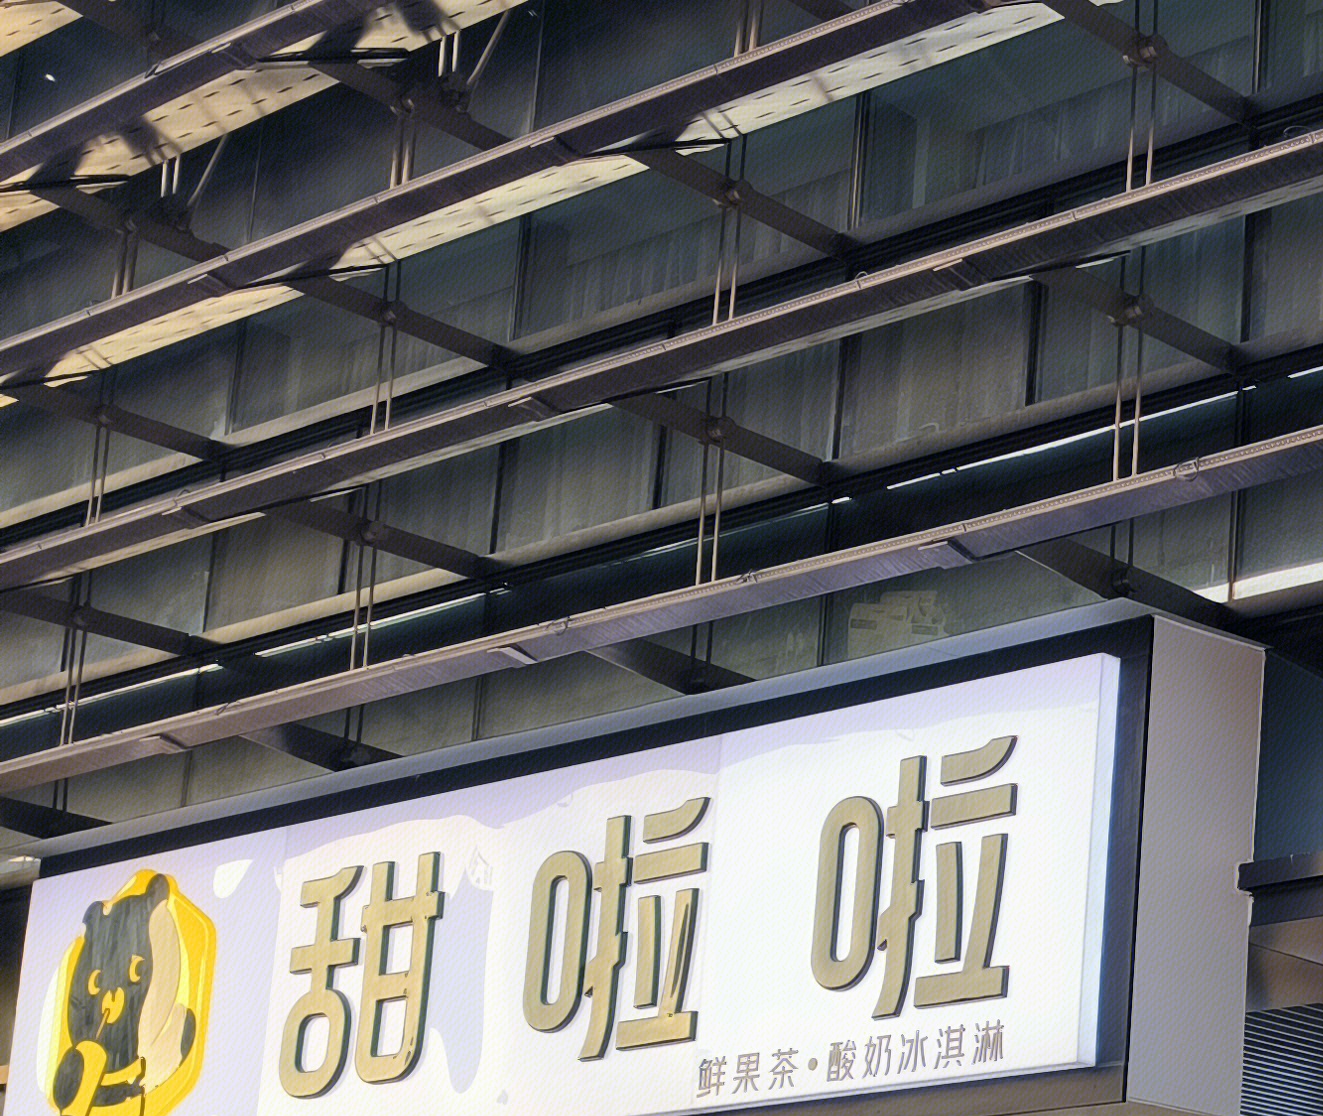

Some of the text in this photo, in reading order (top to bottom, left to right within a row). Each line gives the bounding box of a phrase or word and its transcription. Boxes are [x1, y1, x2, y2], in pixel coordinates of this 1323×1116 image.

[278, 735, 1019, 1099] 甜啦啦
[696, 1019, 1004, 1098] 鲜果茶·酸奶冰淇淋
